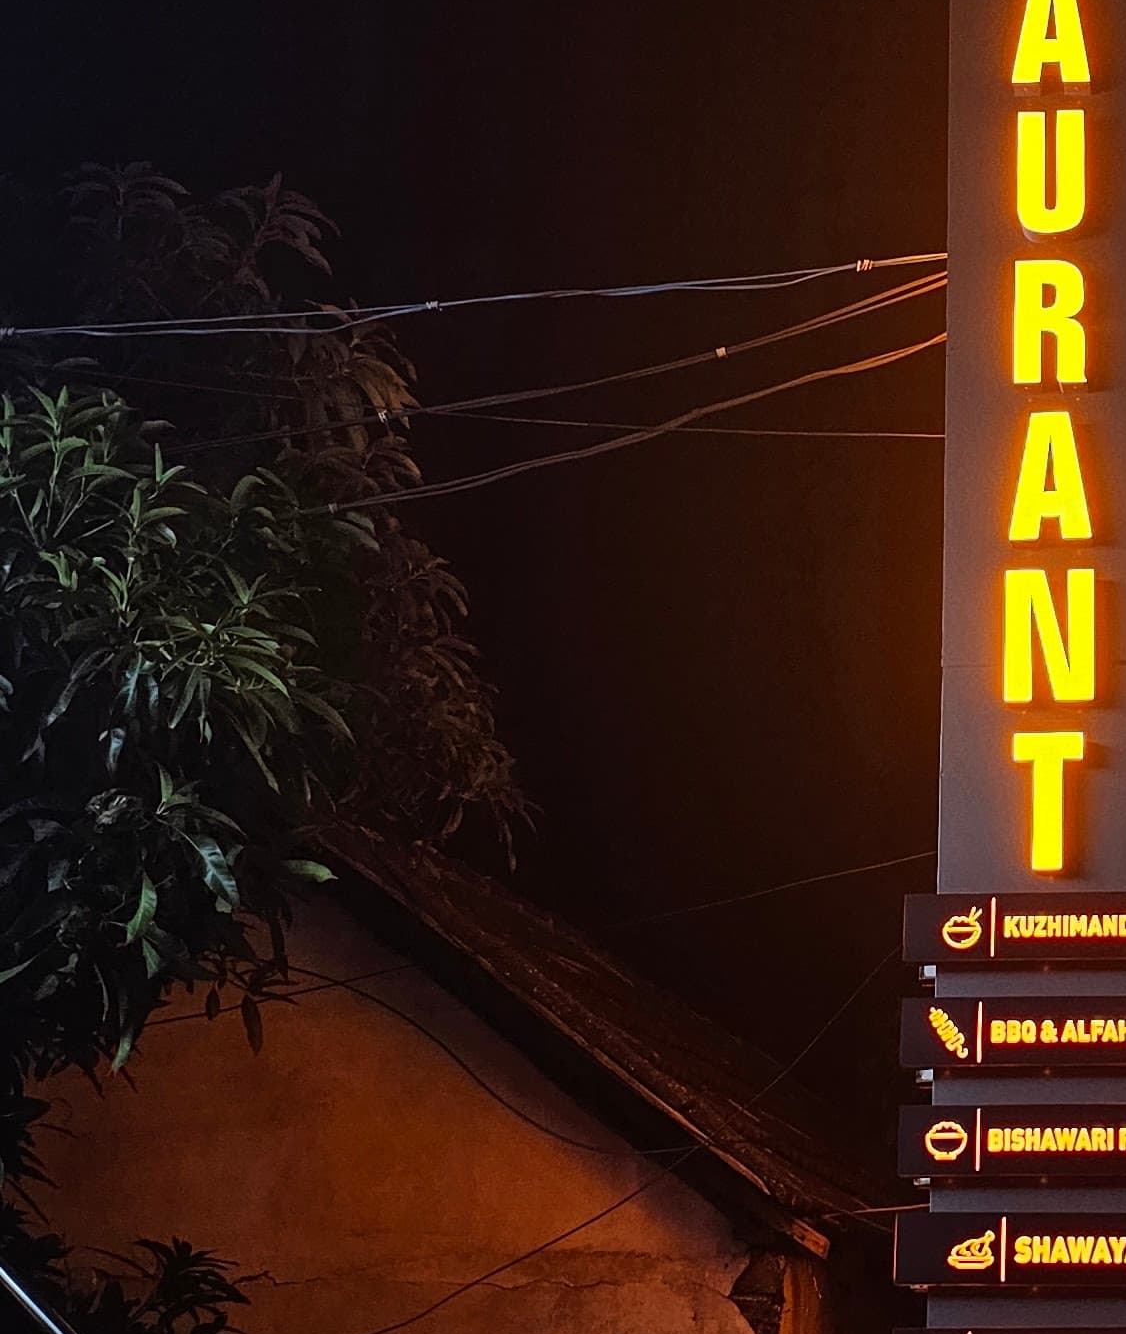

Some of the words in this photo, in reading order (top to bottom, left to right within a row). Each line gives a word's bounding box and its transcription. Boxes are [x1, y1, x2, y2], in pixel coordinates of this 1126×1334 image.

[989, 1019, 1037, 1044] BBQ
[1039, 1019, 1059, 1044] &
[987, 1127, 1115, 1153] BISHAWARI
